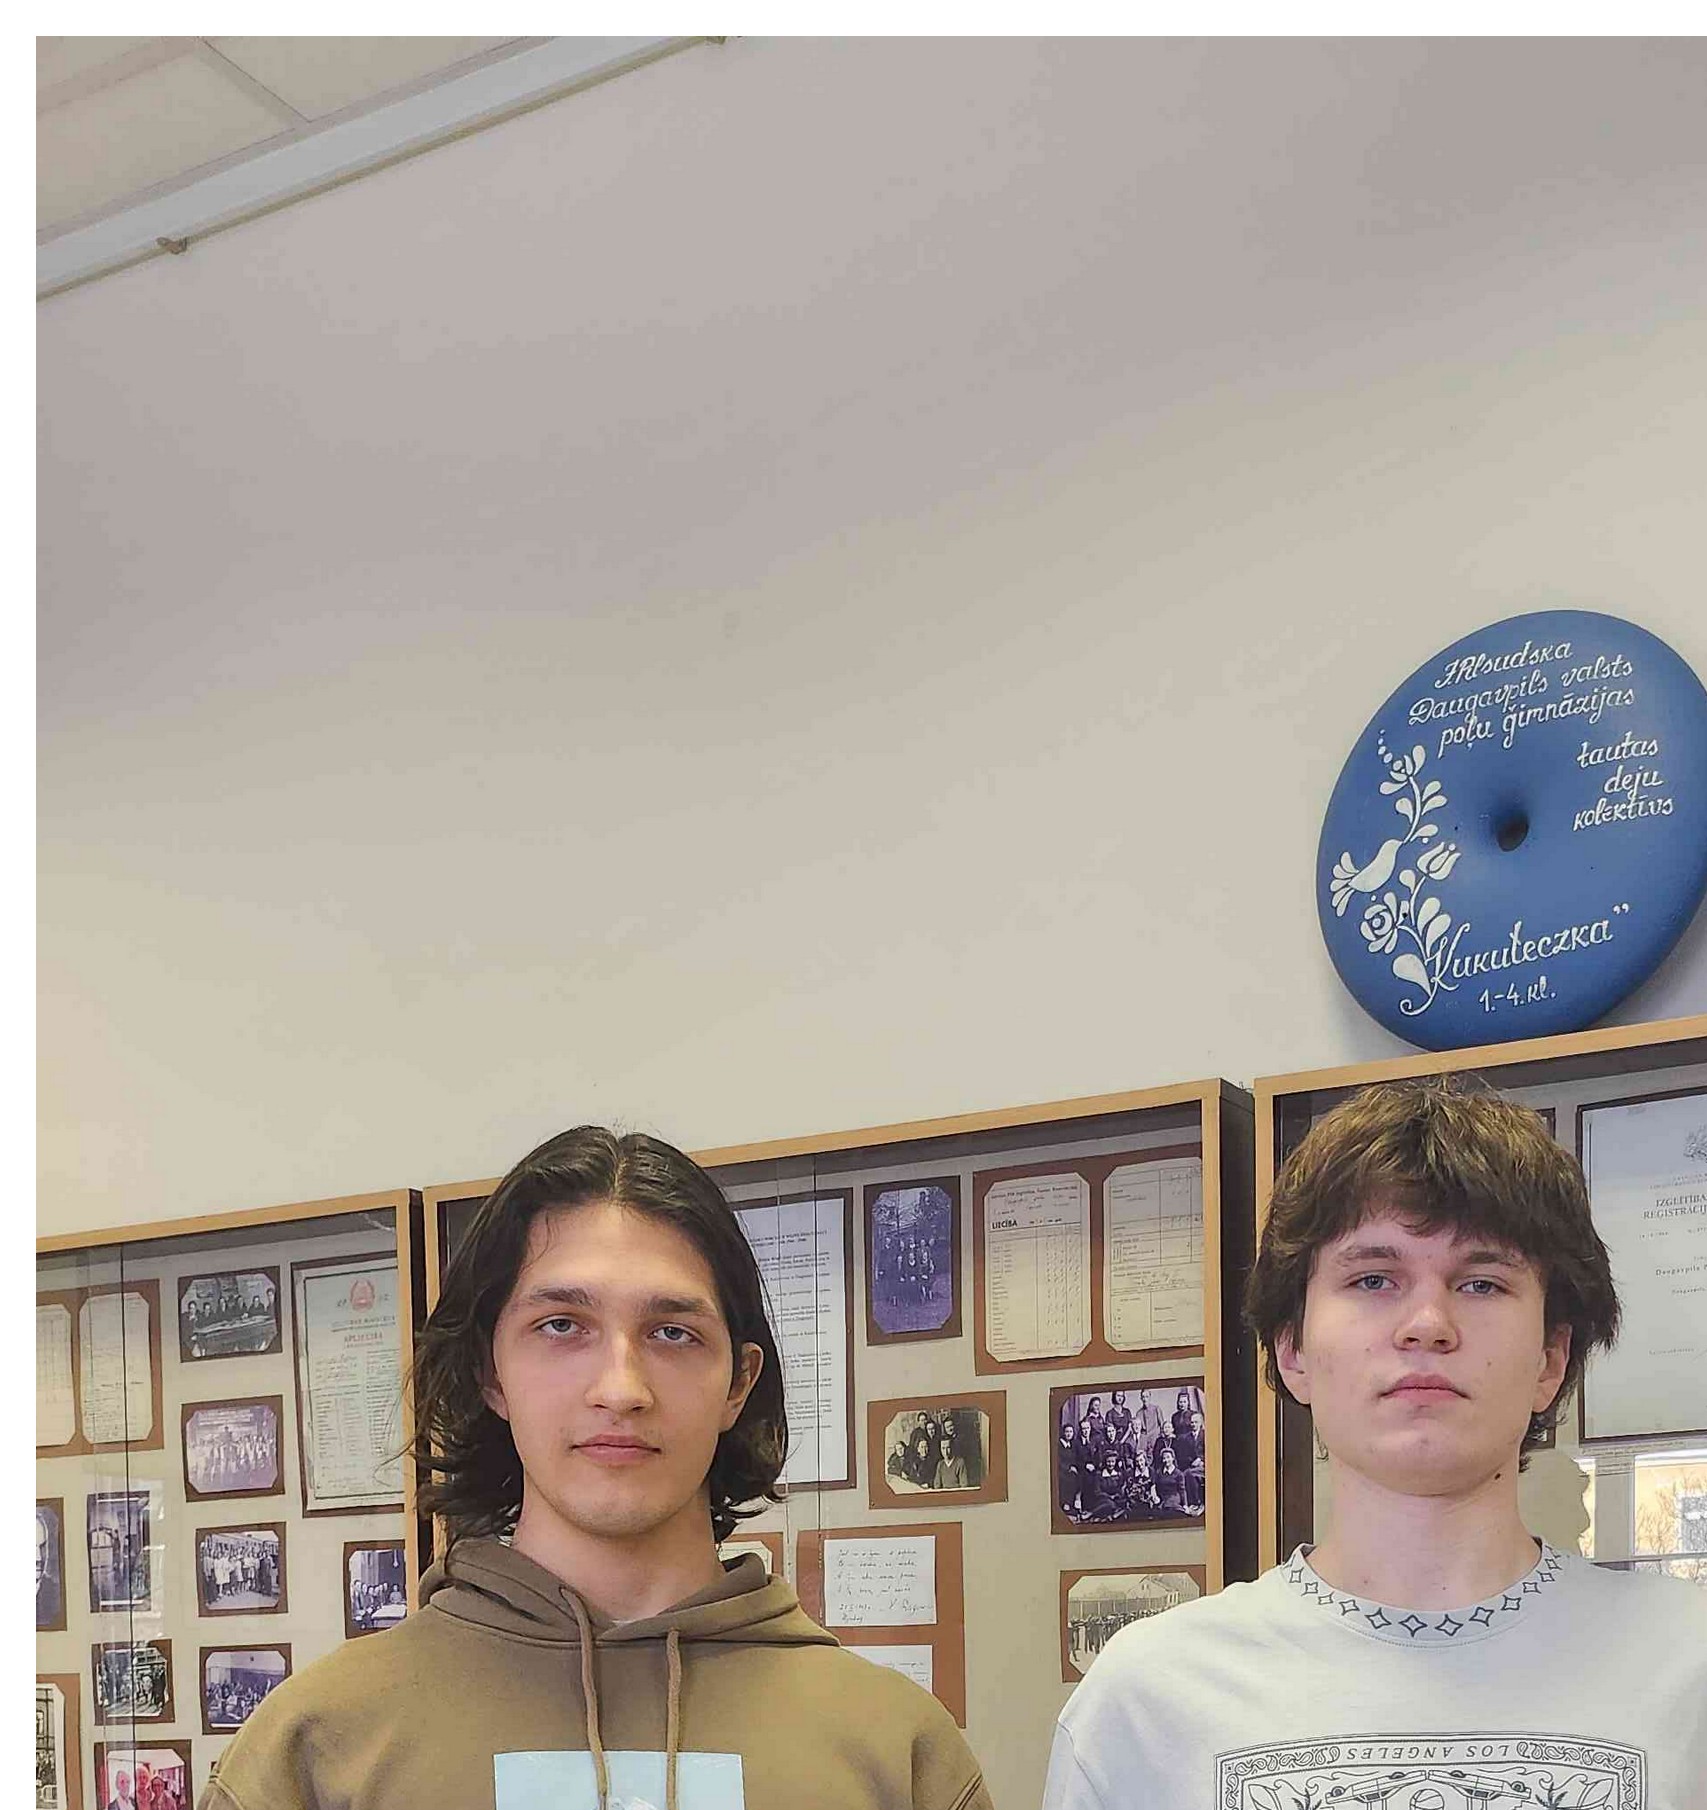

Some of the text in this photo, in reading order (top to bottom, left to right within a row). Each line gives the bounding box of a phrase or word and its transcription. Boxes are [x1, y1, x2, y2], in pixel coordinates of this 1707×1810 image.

[1408, 654, 1634, 726] Daugavpils valsts
[1576, 731, 1660, 768] tautas
[1603, 765, 1664, 801] deju
[1573, 794, 1674, 831] kolektīvs
[1346, 1744, 1511, 1761] LOS ANGELES
